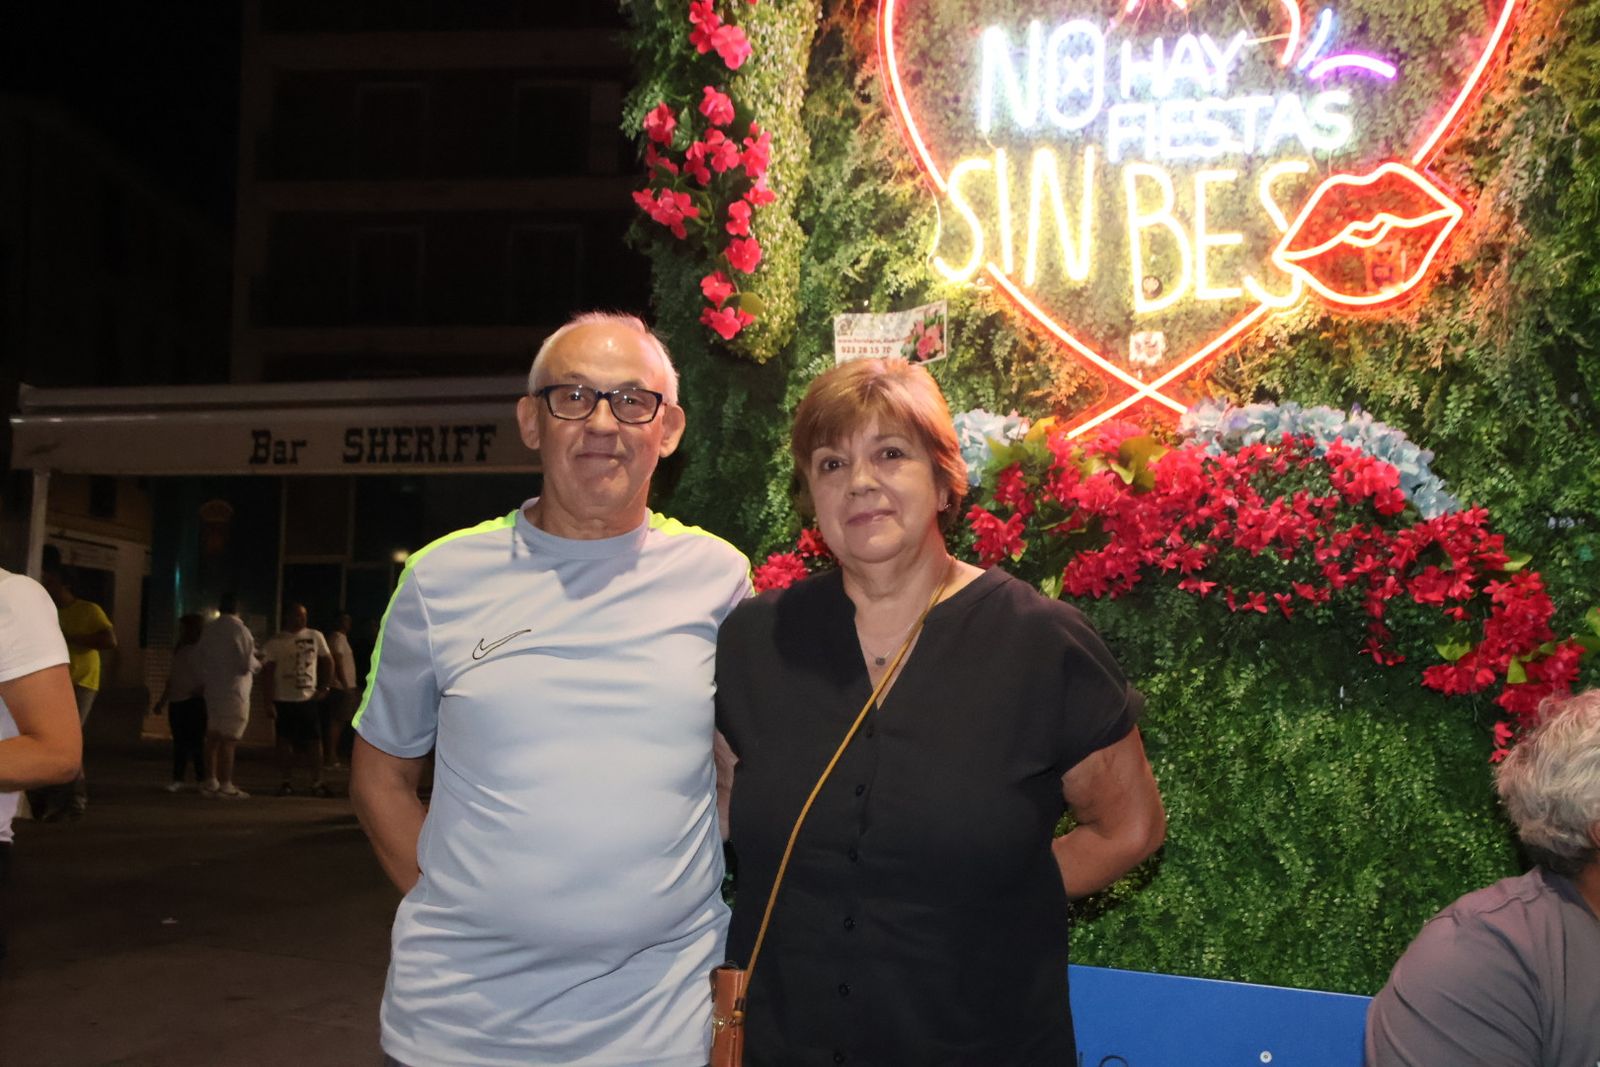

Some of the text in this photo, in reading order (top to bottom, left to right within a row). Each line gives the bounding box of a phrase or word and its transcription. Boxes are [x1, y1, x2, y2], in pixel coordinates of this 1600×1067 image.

[979, 19, 1248, 132] NO HAY
[1107, 91, 1354, 162] FIESTAS
[933, 147, 1096, 287] SIN
[249, 425, 497, 465] Bar SHERIFF
